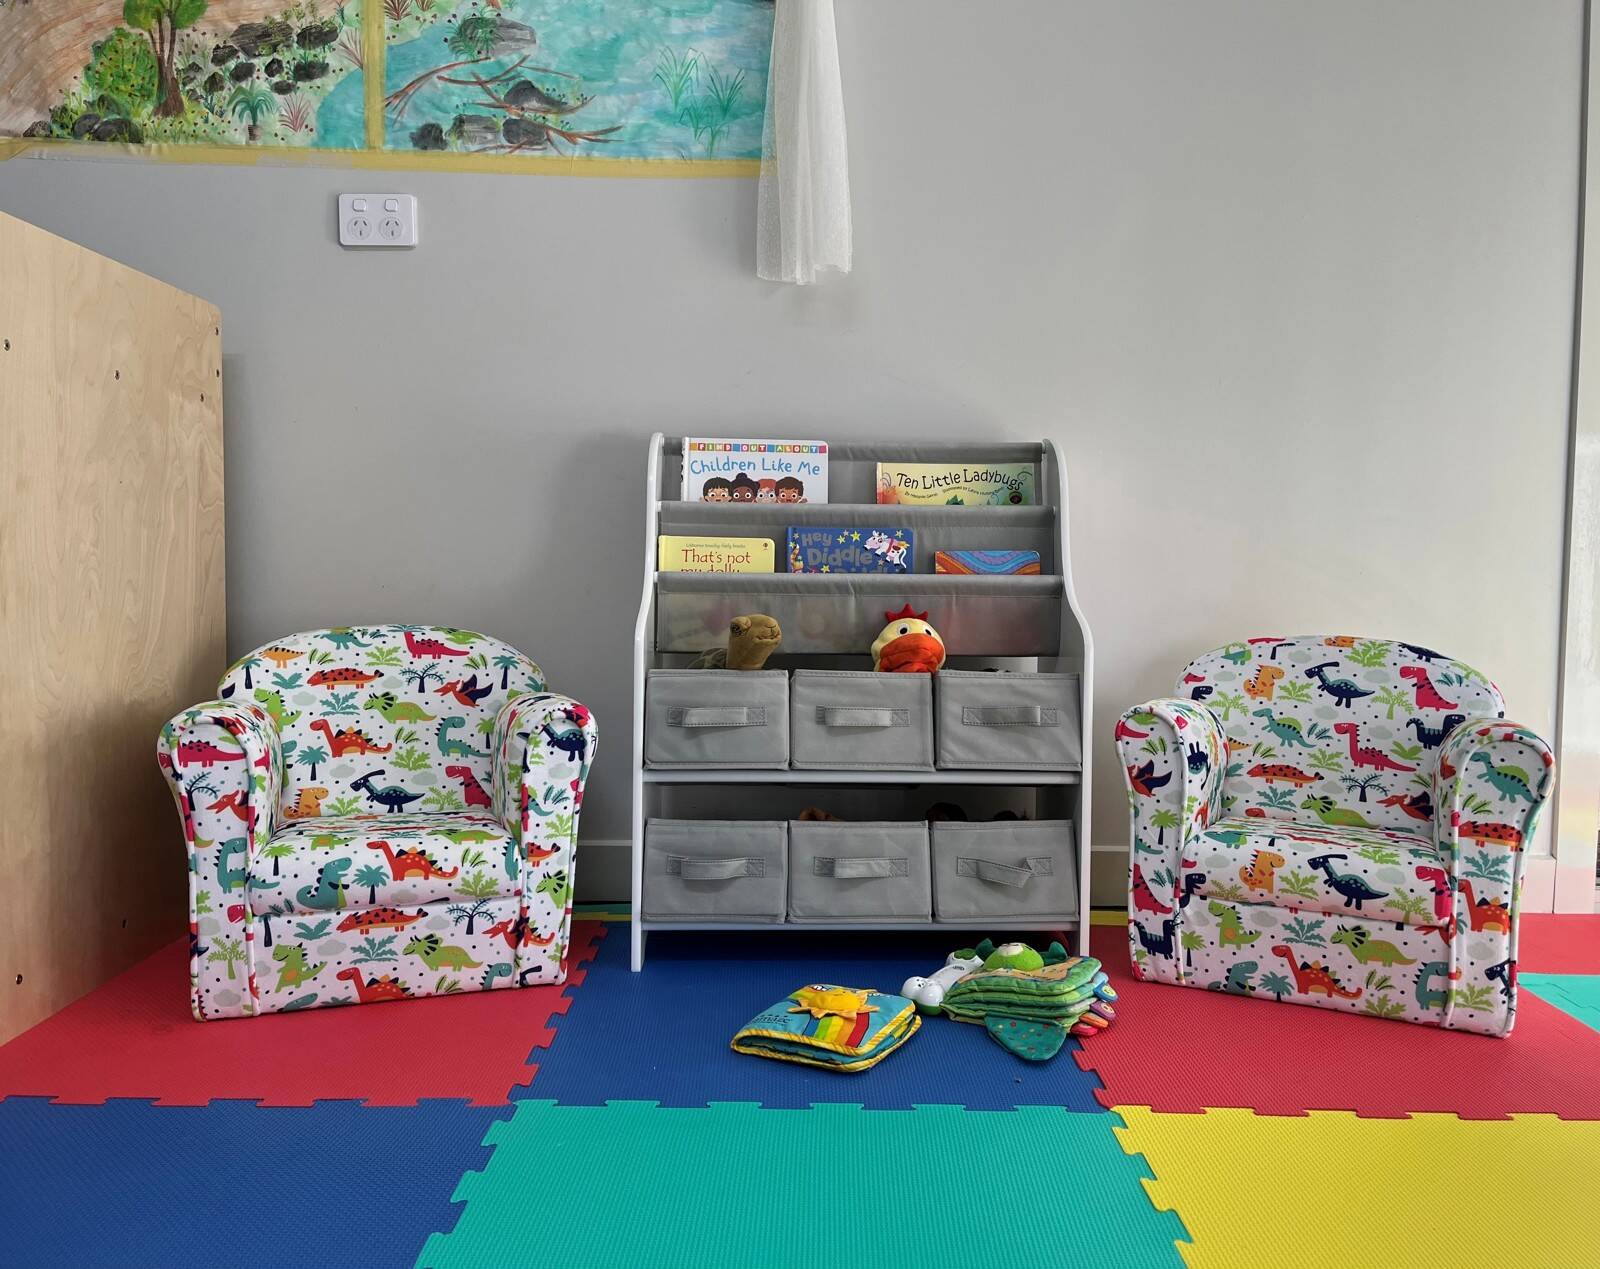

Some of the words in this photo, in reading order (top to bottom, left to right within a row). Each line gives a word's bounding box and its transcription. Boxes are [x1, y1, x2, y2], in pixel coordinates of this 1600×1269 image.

[699, 443, 732, 451] FIND
[742, 444, 767, 452] OUT
[776, 445, 818, 453] ABOUT
[690, 454, 756, 475] Children
[762, 457, 792, 473] Like
[797, 461, 820, 476] Me
[896, 472, 919, 489] Ten
[922, 471, 961, 490] Little
[963, 468, 1024, 491] Ladybugs
[801, 532, 833, 546] Hey
[681, 548, 722, 563] That's
[727, 551, 751, 564] not
[806, 544, 873, 567] Diddle
